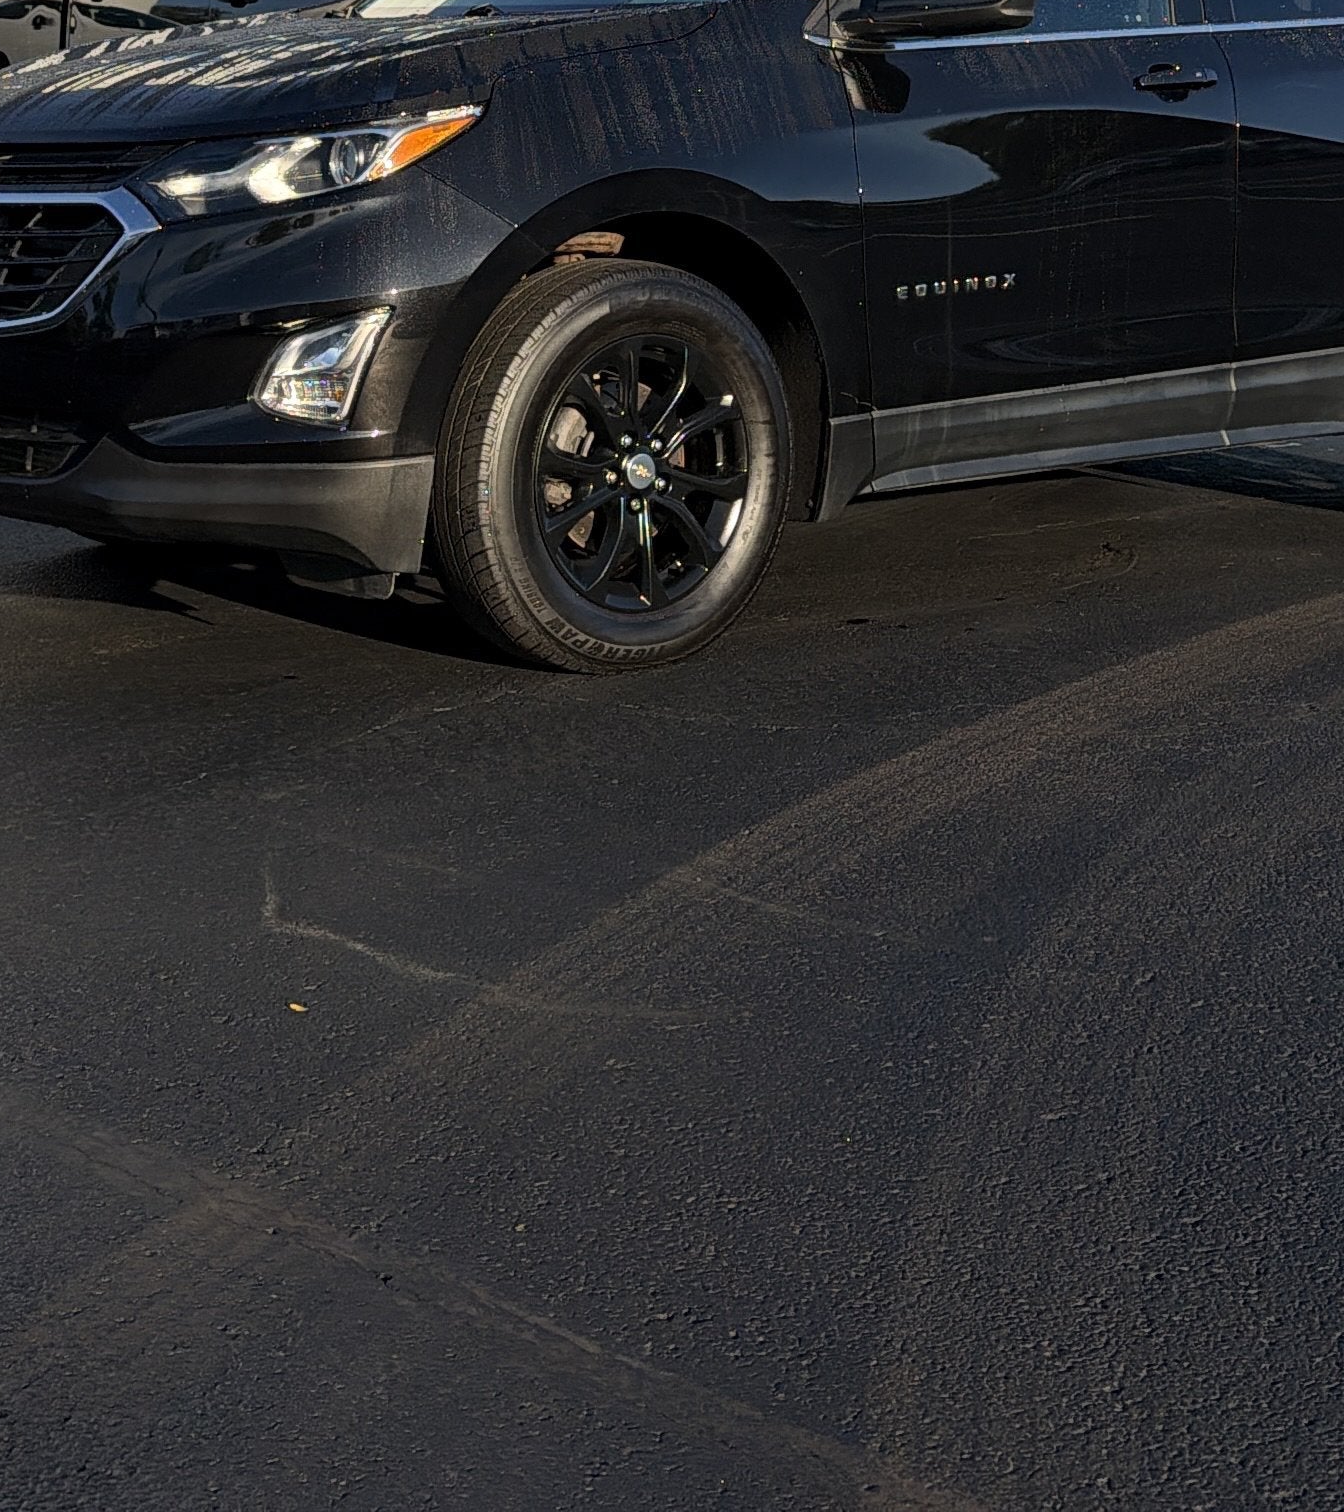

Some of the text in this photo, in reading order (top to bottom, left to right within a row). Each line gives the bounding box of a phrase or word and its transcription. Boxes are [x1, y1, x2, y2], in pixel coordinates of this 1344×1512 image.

[896, 273, 1016, 299] EQUINOX
[544, 617, 590, 650] PAW
[602, 644, 666, 662] TIGER
